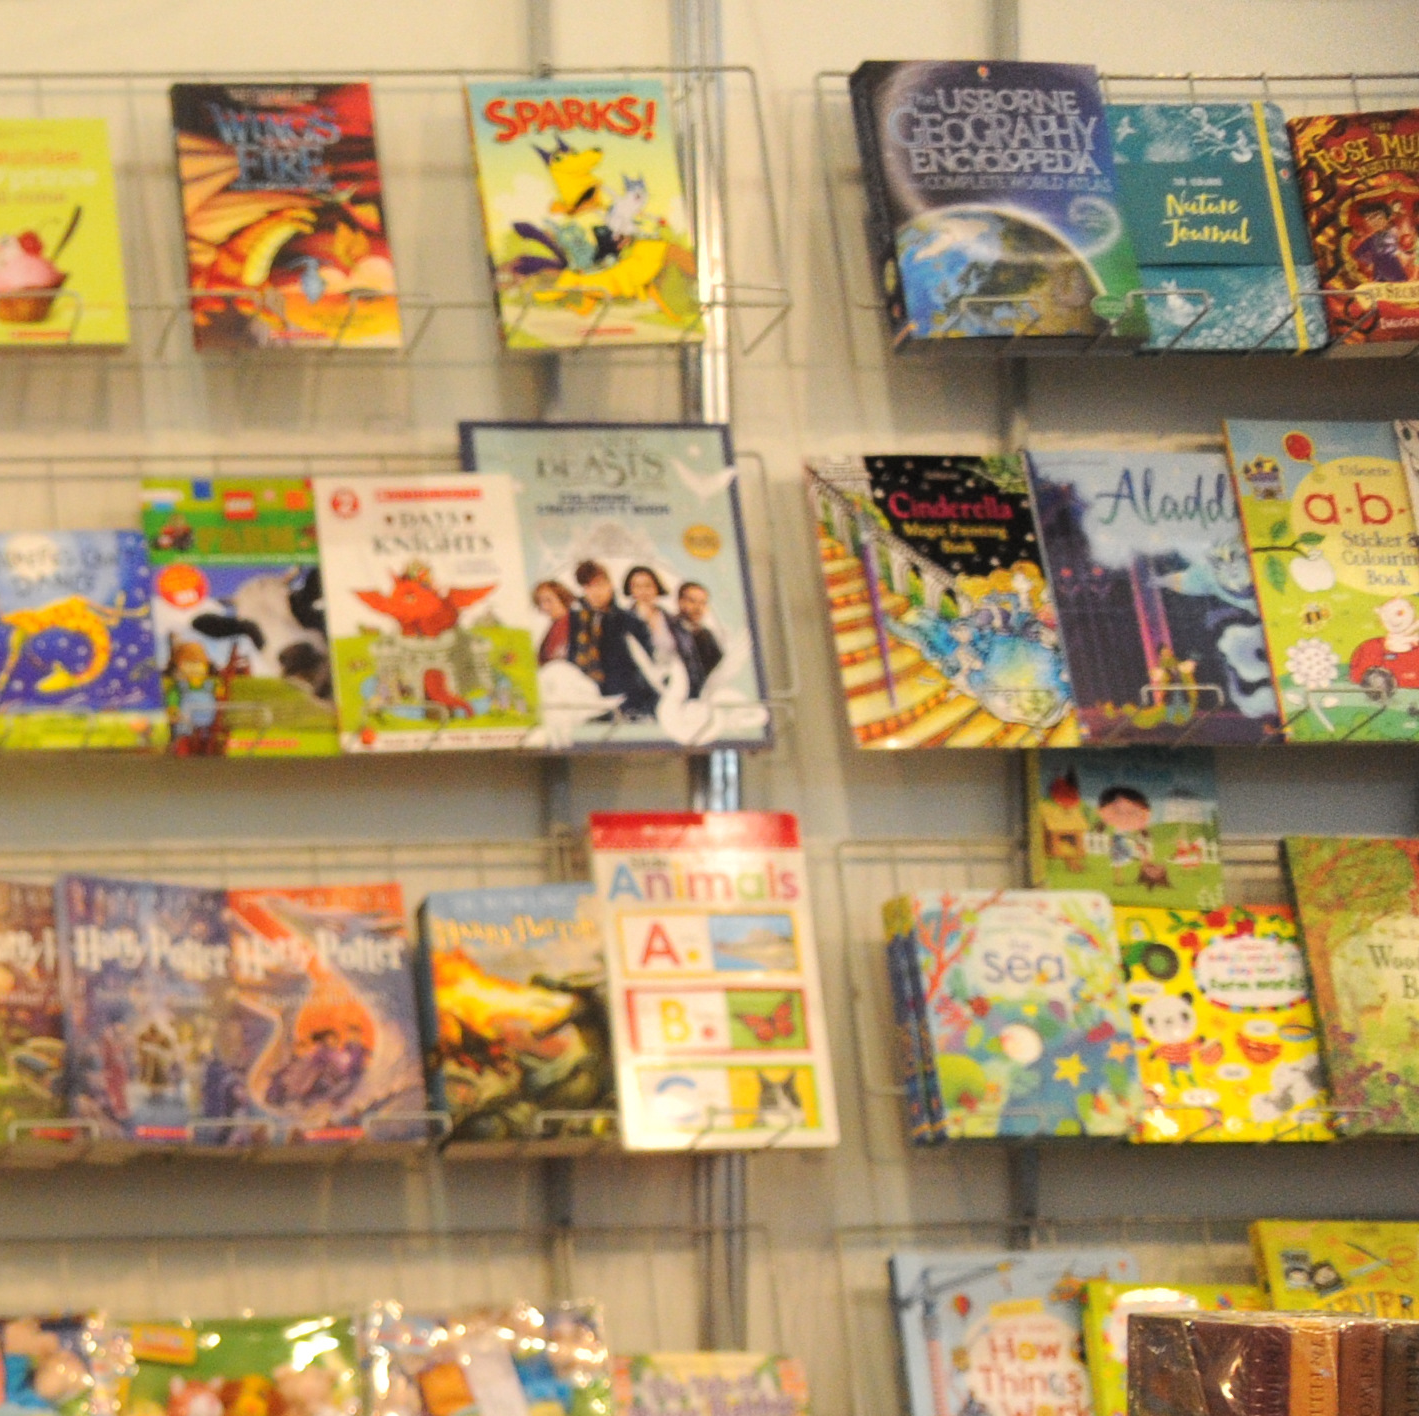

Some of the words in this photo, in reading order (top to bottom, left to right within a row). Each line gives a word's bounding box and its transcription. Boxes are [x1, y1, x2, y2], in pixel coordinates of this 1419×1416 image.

[483, 97, 657, 143] SPARKS!
[938, 86, 1081, 117] USBORNE
[211, 103, 341, 147] WINGS
[889, 106, 1100, 154] GEOGRAPHY
[237, 144, 327, 184] FIRE
[911, 150, 1103, 176] ENCYCLOPEDIA
[1314, 136, 1373, 174] ROSE
[1164, 193, 1242, 218] Nature
[1164, 218, 1252, 247] Journal
[534, 450, 666, 487] BEASTS
[1337, 462, 1391, 478] Usborne
[888, 491, 1014, 521] Cinderella
[372, 535, 493, 555] KNIGHTS
[1341, 530, 1401, 551] Sticker
[1365, 568, 1412, 588] Book
[606, 860, 801, 904] Animals
[74, 922, 145, 969] Harry
[149, 935, 230, 972] Potter
[232, 934, 309, 977] Harry
[315, 932, 409, 974] Potter
[639, 922, 681, 967] A
[981, 947, 1067, 985] sea
[660, 1001, 687, 1043] B
[988, 1337, 1061, 1365] How
[978, 1364, 1083, 1397] Things
